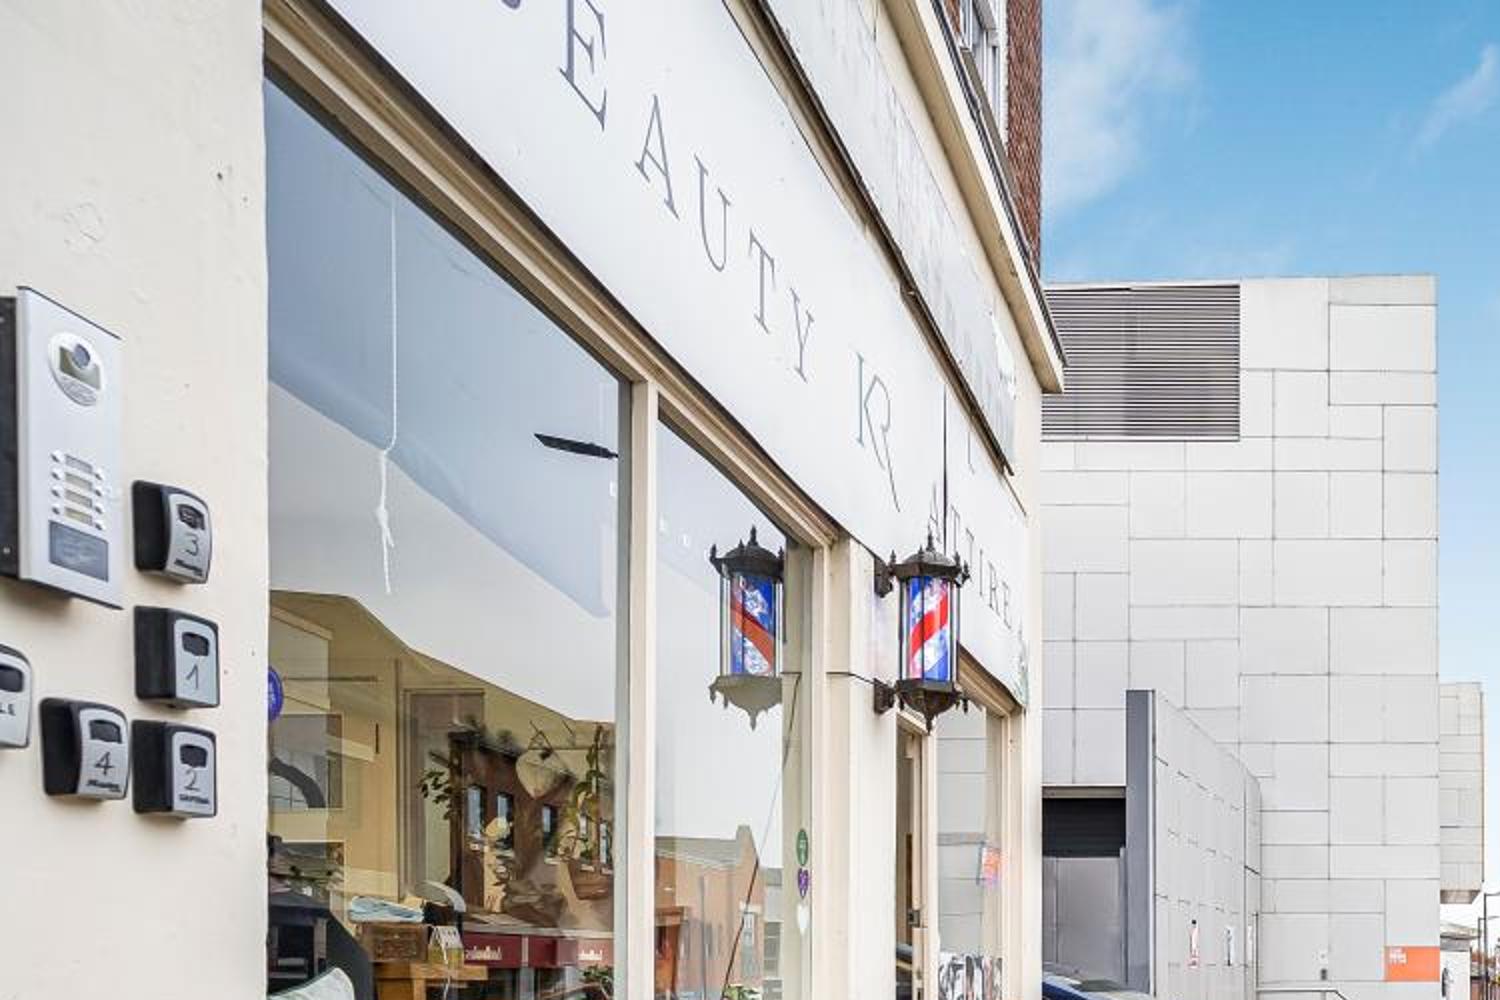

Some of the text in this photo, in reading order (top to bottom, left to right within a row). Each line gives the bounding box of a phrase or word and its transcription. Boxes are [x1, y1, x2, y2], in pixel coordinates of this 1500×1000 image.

[500, 0, 814, 384] EAUTY
[184, 532, 200, 556] 3
[186, 663, 199, 689] 1
[94, 750, 115, 776] 4
[183, 769, 201, 792] 2
